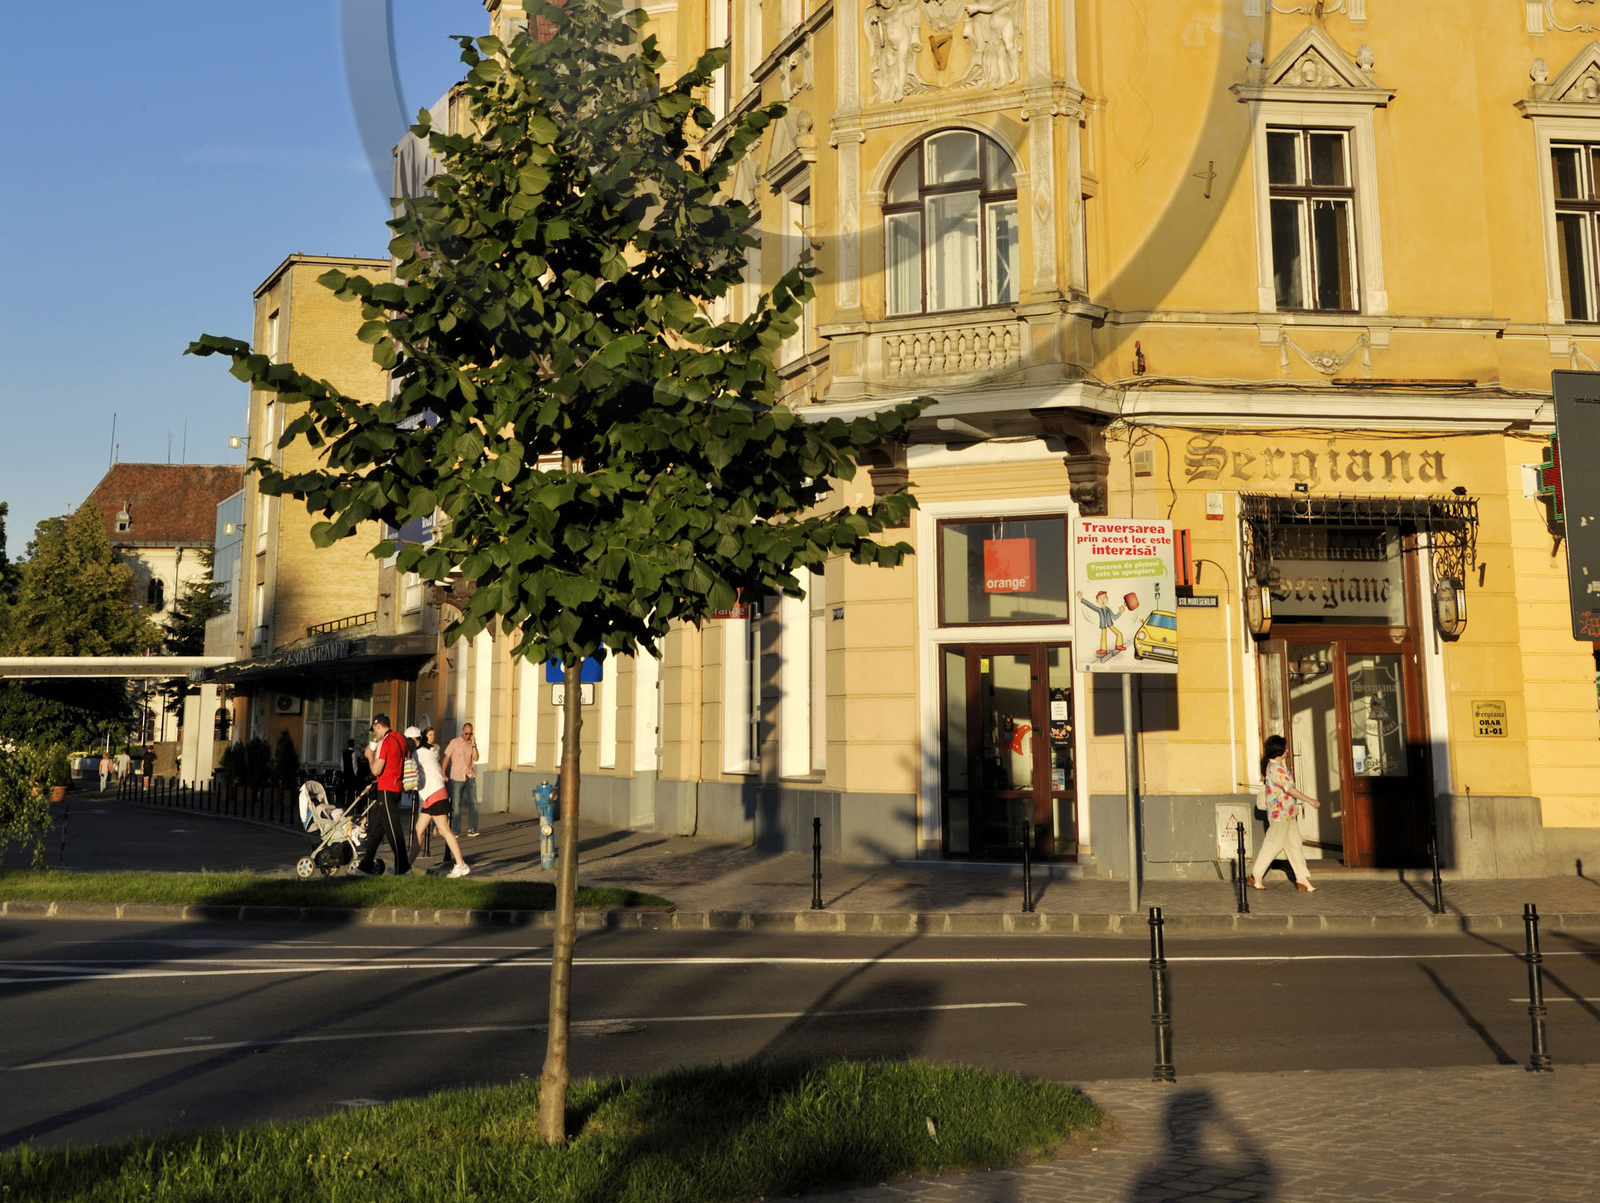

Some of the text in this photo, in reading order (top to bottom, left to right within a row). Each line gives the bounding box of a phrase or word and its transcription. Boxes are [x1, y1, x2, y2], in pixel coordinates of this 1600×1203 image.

[1184, 433, 1448, 490] Sergiana
[1082, 522, 1165, 534] Traversarea
[1077, 535, 1172, 545] prin acest loc este
[1092, 544, 1157, 556] interzisă!
[1272, 539, 1387, 562] Restaurant
[986, 578, 1026, 590] orange
[1268, 567, 1391, 609] Sergiana
[712, 606, 745, 617] range
